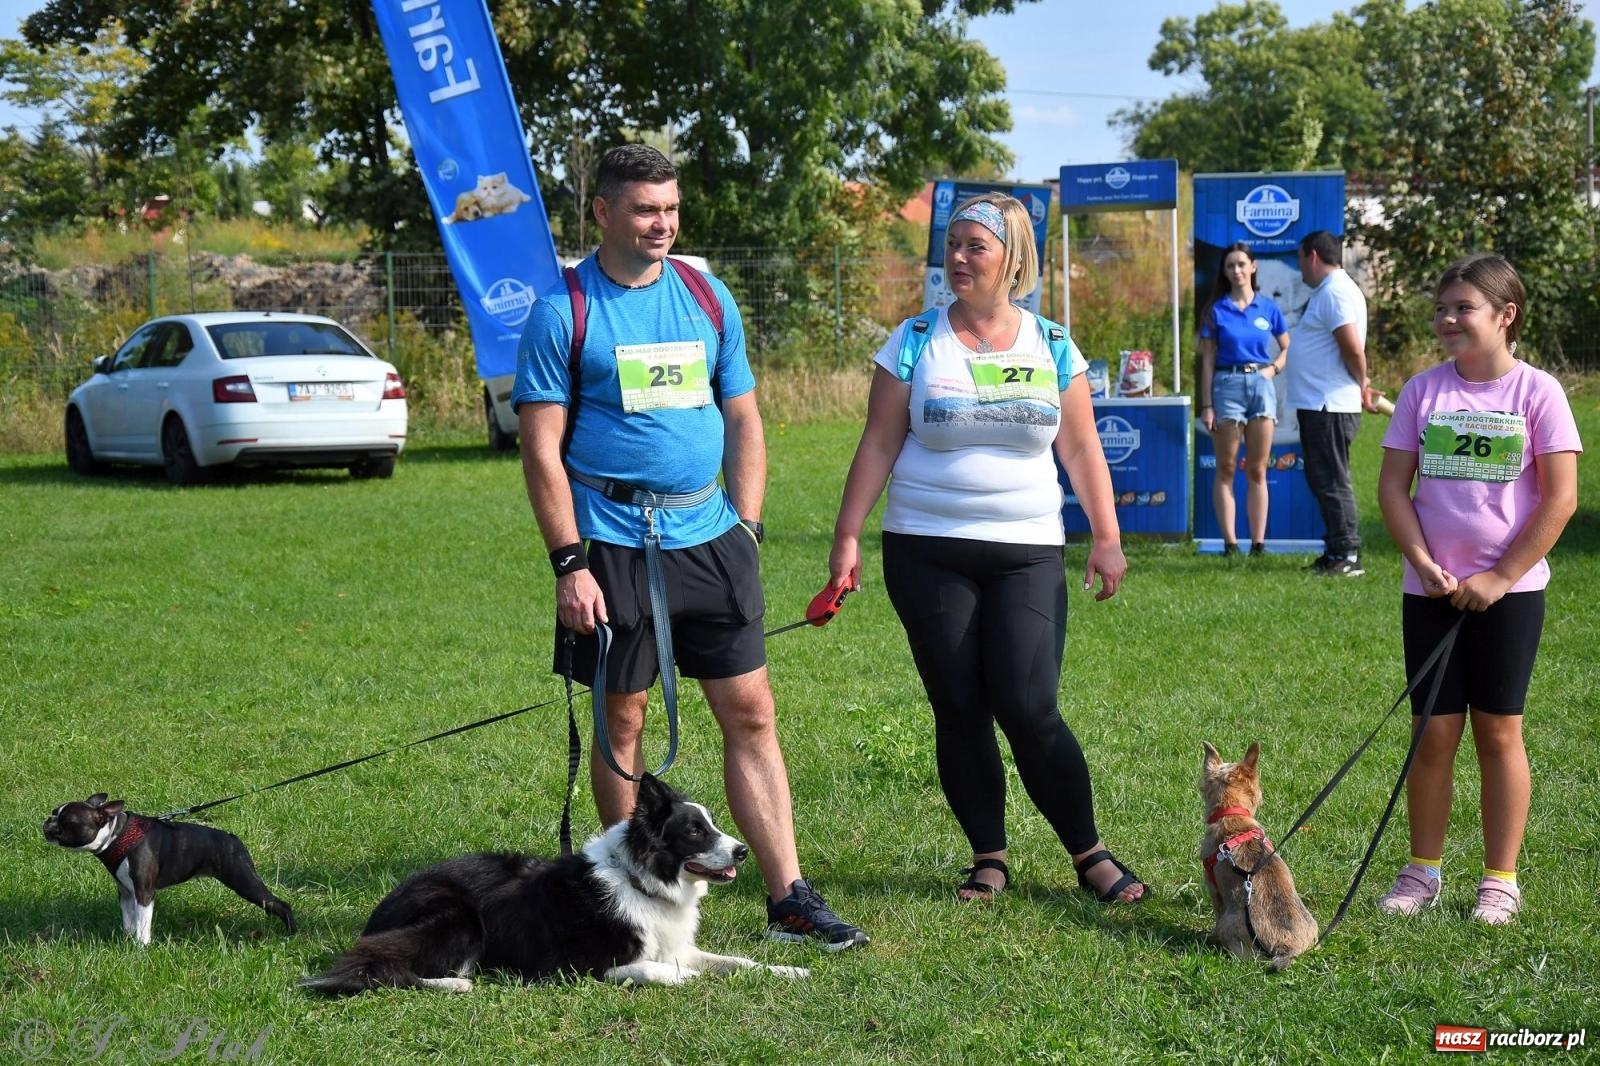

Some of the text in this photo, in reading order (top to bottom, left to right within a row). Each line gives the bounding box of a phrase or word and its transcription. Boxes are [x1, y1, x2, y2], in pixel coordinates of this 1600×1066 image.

[1243, 204, 1293, 217] Farmina
[648, 364, 683, 387] 25
[1002, 367, 1035, 383] 27
[1099, 434, 1135, 445] rmina
[1453, 434, 1492, 458] 26
